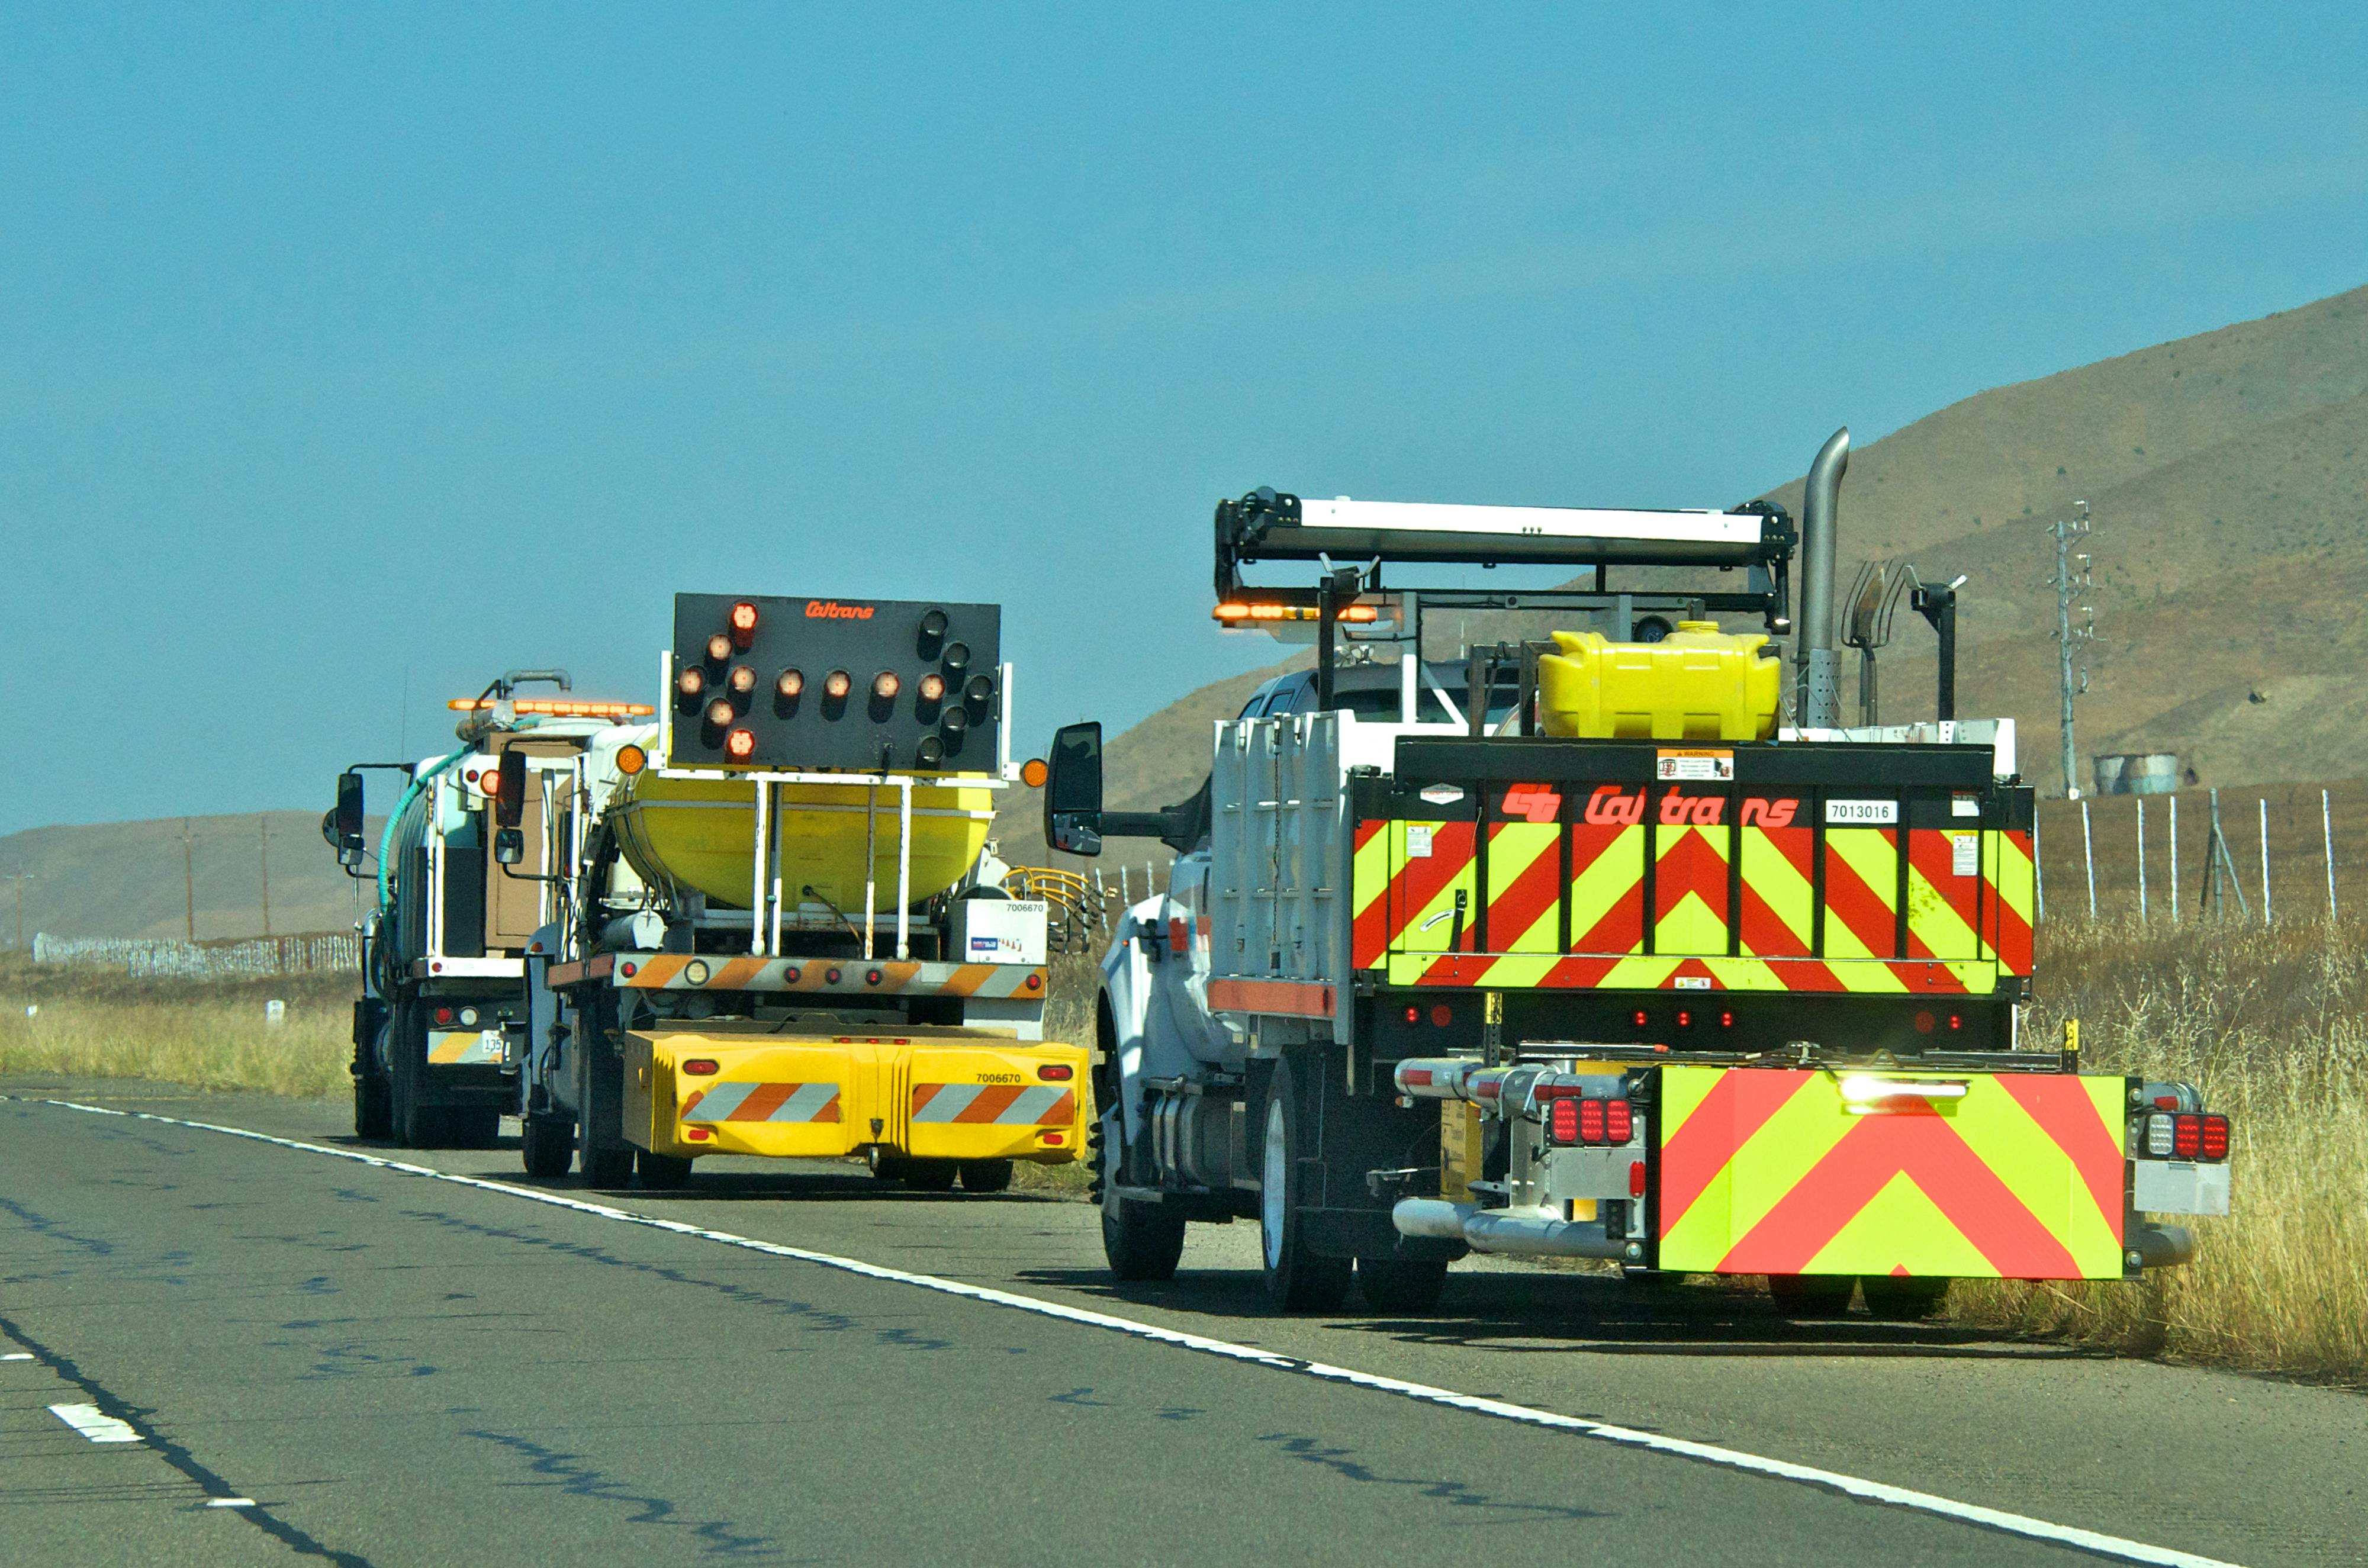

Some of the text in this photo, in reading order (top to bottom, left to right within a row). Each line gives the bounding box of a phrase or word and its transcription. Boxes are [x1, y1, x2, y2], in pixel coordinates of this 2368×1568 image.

[805, 601, 874, 619] Caltrans
[1832, 805, 1889, 818] 7013016
[1006, 904, 1043, 912] 7006670
[976, 1074, 1021, 1083] 7006670
